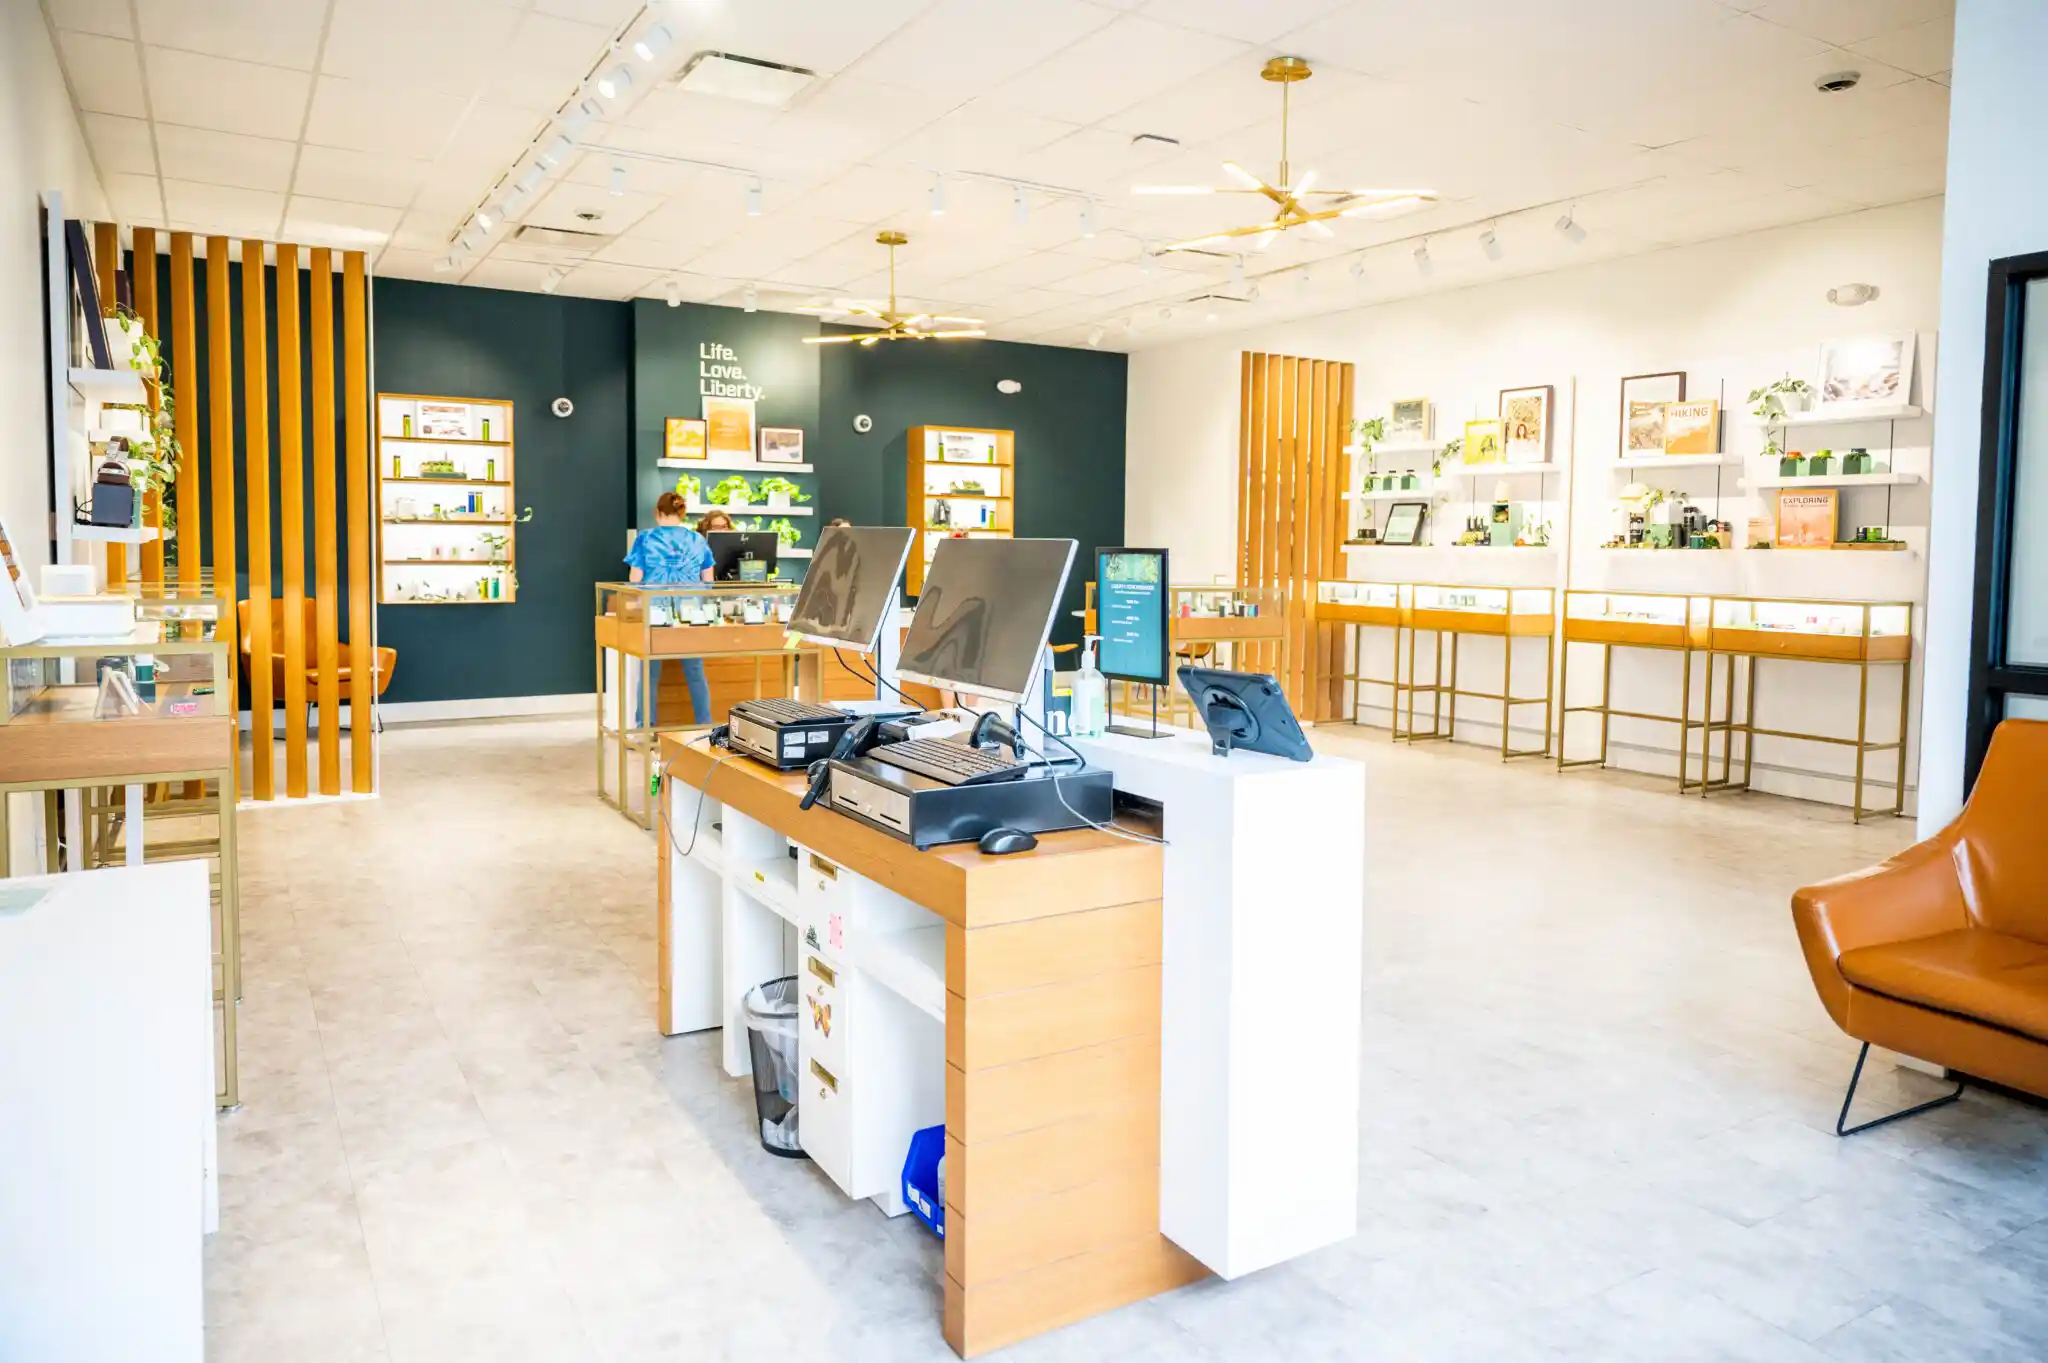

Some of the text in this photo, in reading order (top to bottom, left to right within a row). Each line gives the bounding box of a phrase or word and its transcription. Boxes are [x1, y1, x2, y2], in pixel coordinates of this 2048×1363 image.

[700, 342, 738, 361] Life.
[700, 361, 747, 380] Love.
[700, 378, 766, 402] Liberty.
[1670, 406, 1709, 418] HIKING
[1783, 496, 1829, 504] EXPLORING
